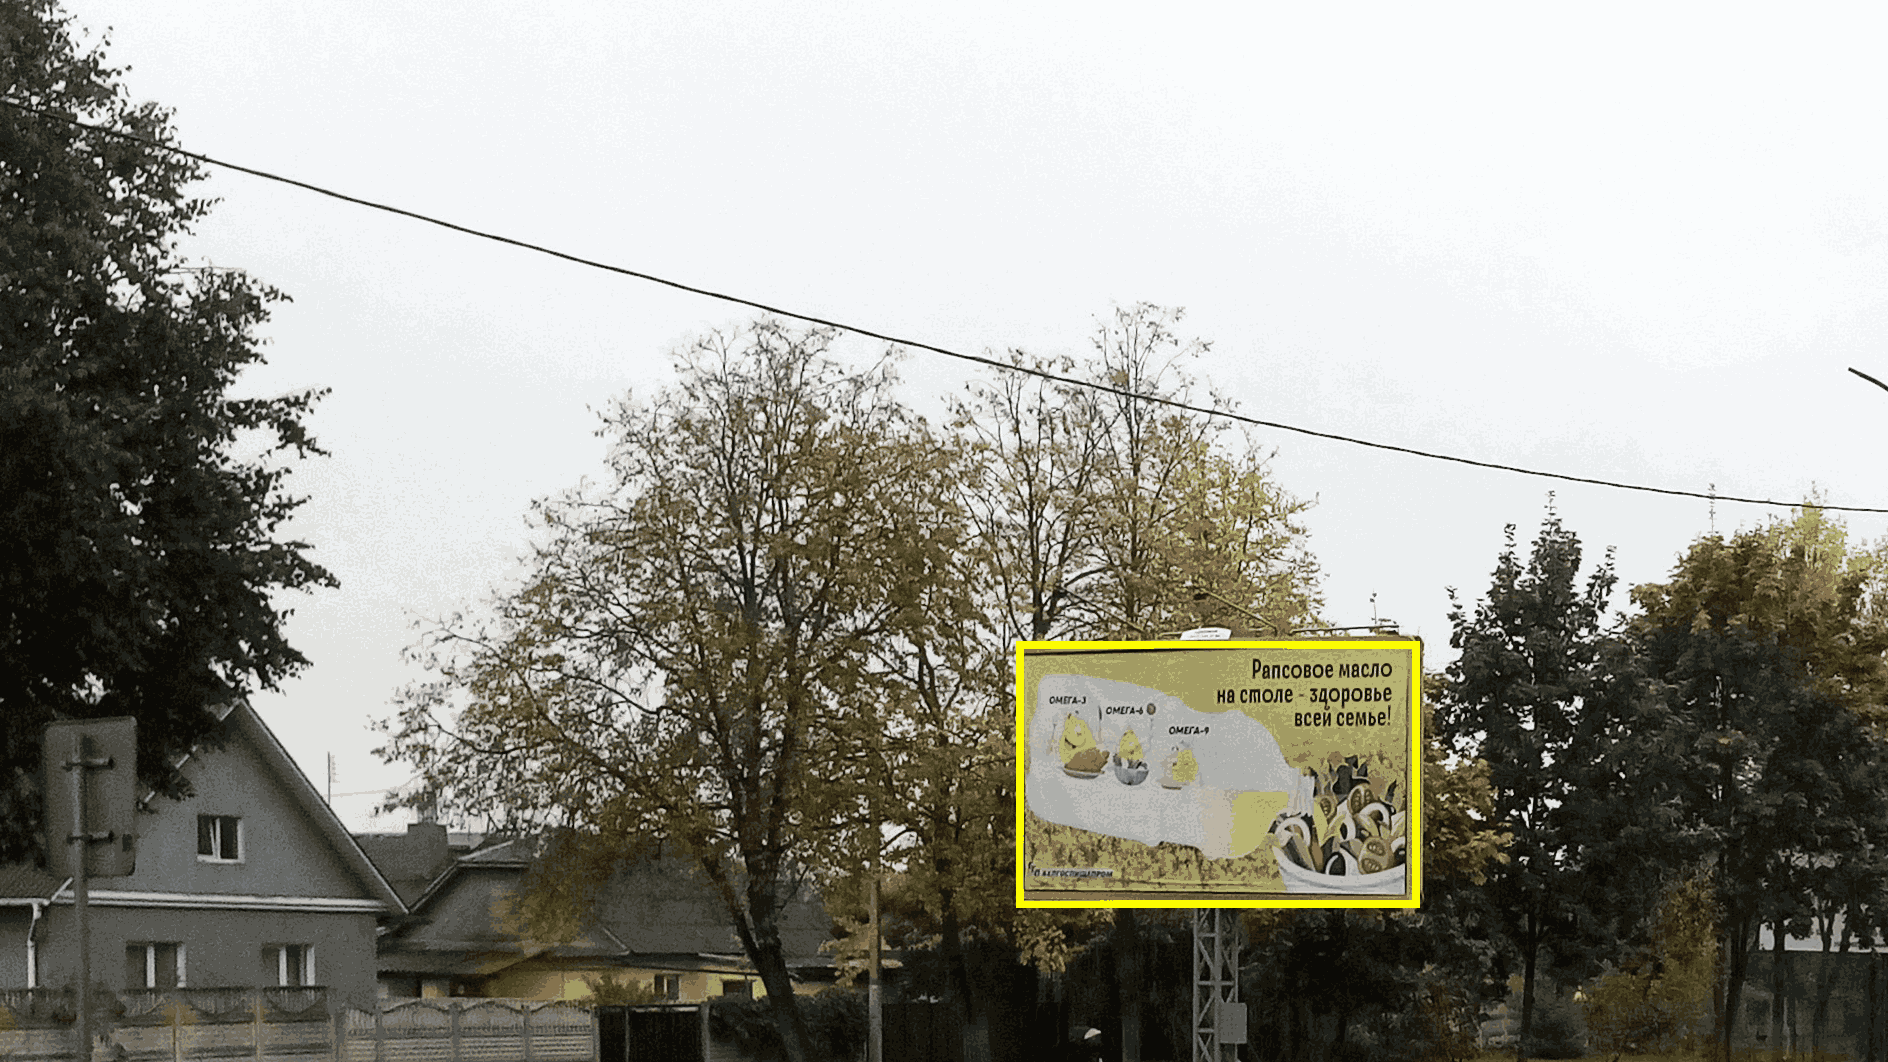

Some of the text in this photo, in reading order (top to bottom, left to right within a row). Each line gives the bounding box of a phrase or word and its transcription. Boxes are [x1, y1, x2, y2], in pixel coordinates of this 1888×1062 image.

[1252, 658, 1393, 680] Рапсовое масло
[1049, 695, 1087, 705] ОМЕГА-3
[1217, 688, 1235, 704] на
[1240, 687, 1294, 704] столе
[1309, 687, 1392, 710] здоровье
[1105, 705, 1144, 715] ОМЕГА-6
[1294, 704, 1392, 727] всей семье!
[1168, 725, 1210, 736] ОМЕГА-9
